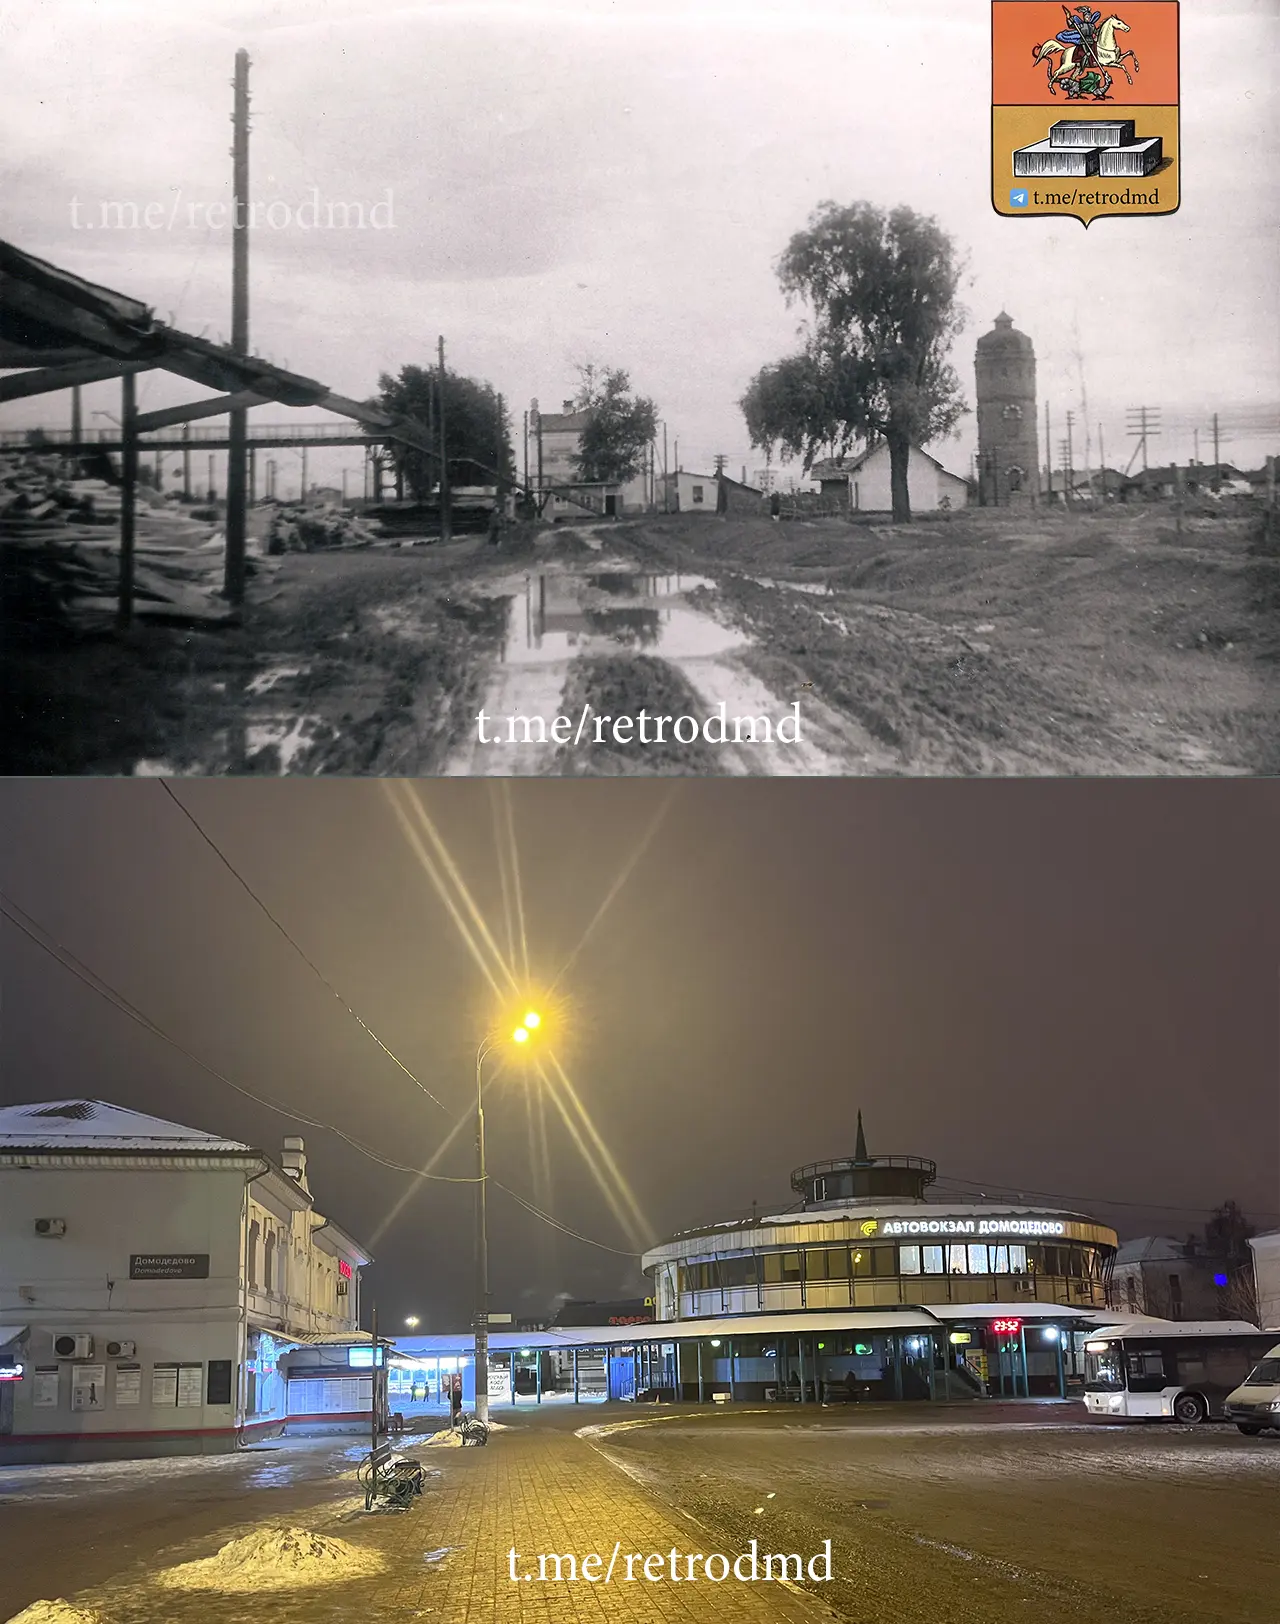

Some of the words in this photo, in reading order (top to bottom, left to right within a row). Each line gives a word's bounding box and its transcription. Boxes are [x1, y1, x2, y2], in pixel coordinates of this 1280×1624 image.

[883, 1220, 975, 1233] АВТОВОКЗАЛ
[978, 1220, 1064, 1234] ДОМОДЕДОВО
[134, 1256, 196, 1266] Домодедово
[994, 1320, 1019, 1332] 23:52
